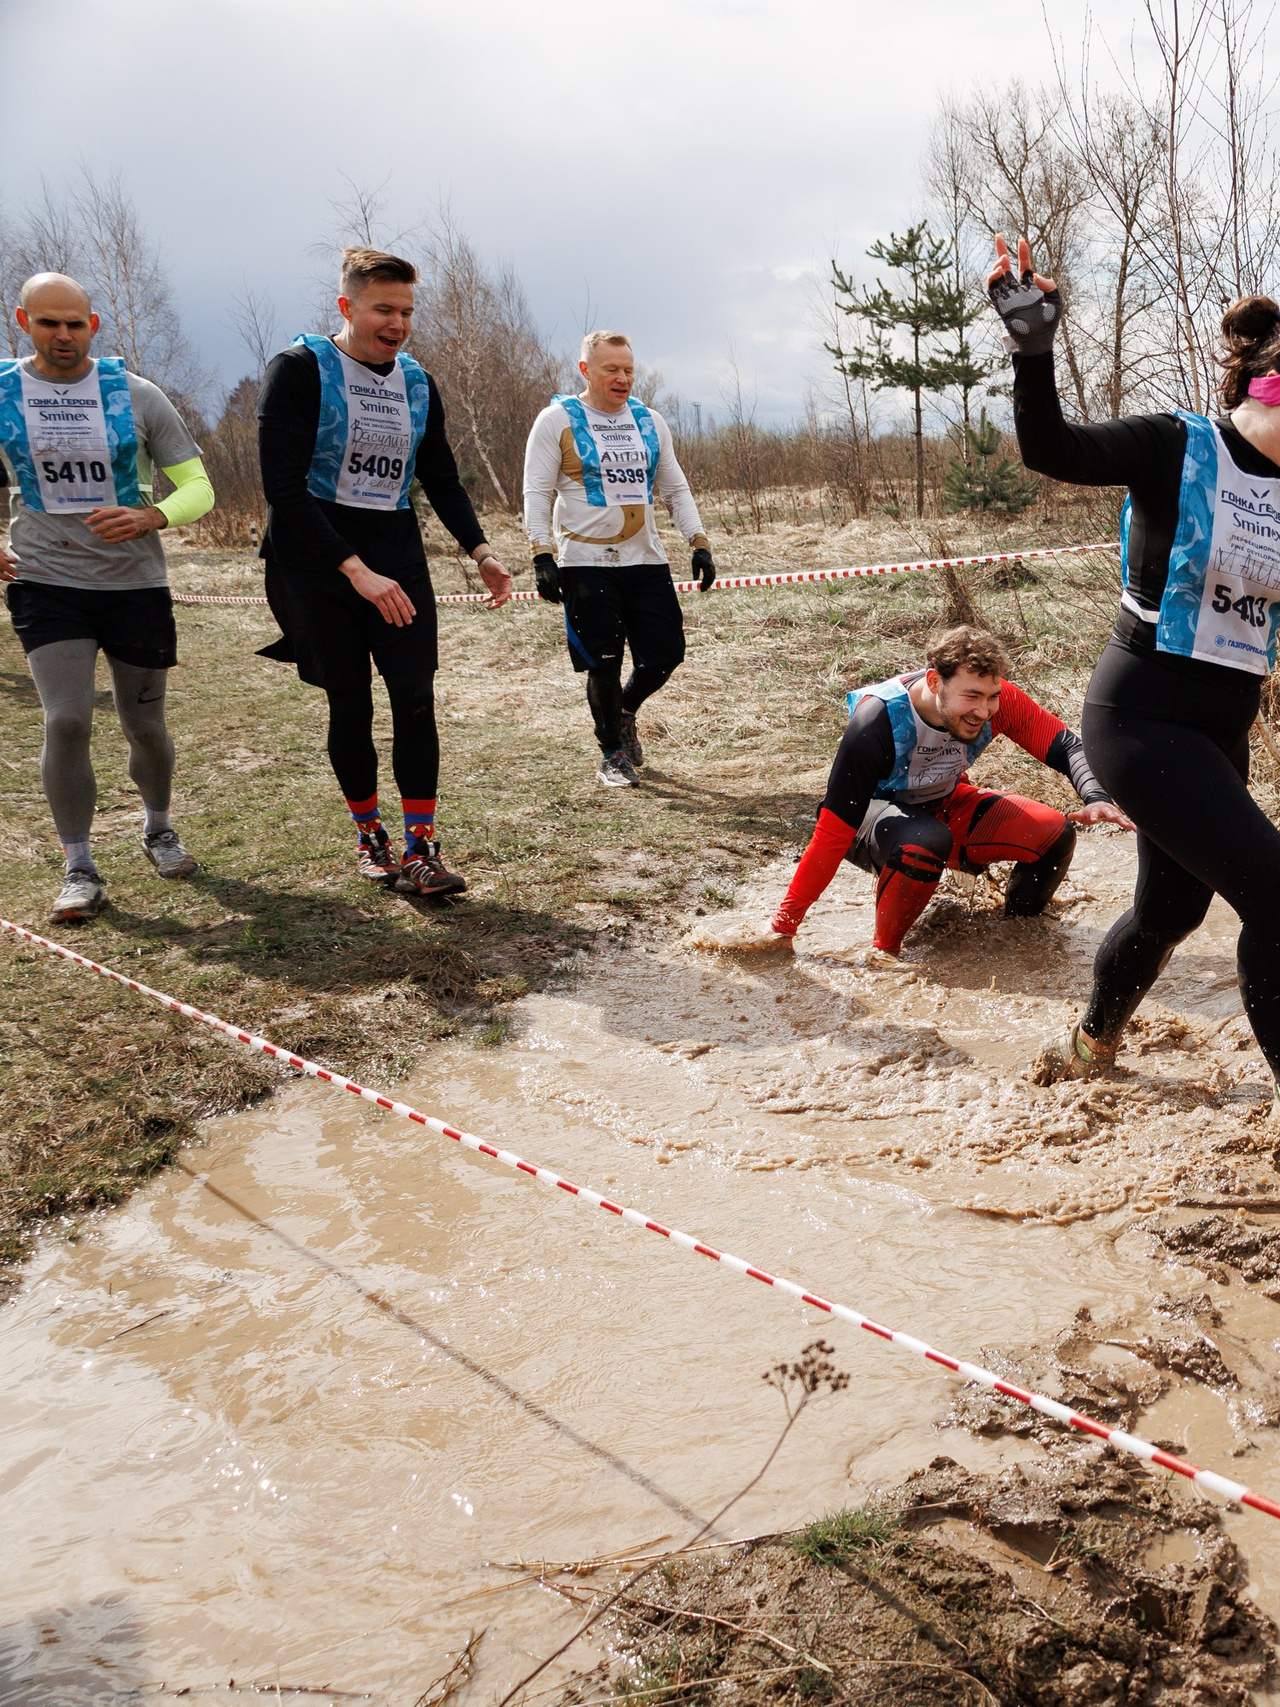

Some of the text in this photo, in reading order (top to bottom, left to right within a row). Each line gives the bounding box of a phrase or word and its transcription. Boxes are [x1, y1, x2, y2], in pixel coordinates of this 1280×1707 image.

[349, 385, 405, 400] ГОНКА ГЕРОЕВ
[39, 410, 90, 421] Sminex
[360, 400, 401, 416] Sminex
[601, 433, 633, 442] Sminex
[42, 460, 107, 483] 5410
[348, 453, 403, 480] 5409
[605, 468, 645, 483] 5399
[1221, 490, 1255, 512] ГОНКА
[1231, 543, 1245, 552] FINE
[1212, 584, 1268, 627] 5413
[1228, 640, 1267, 656] ГАЗПРОМБАН
